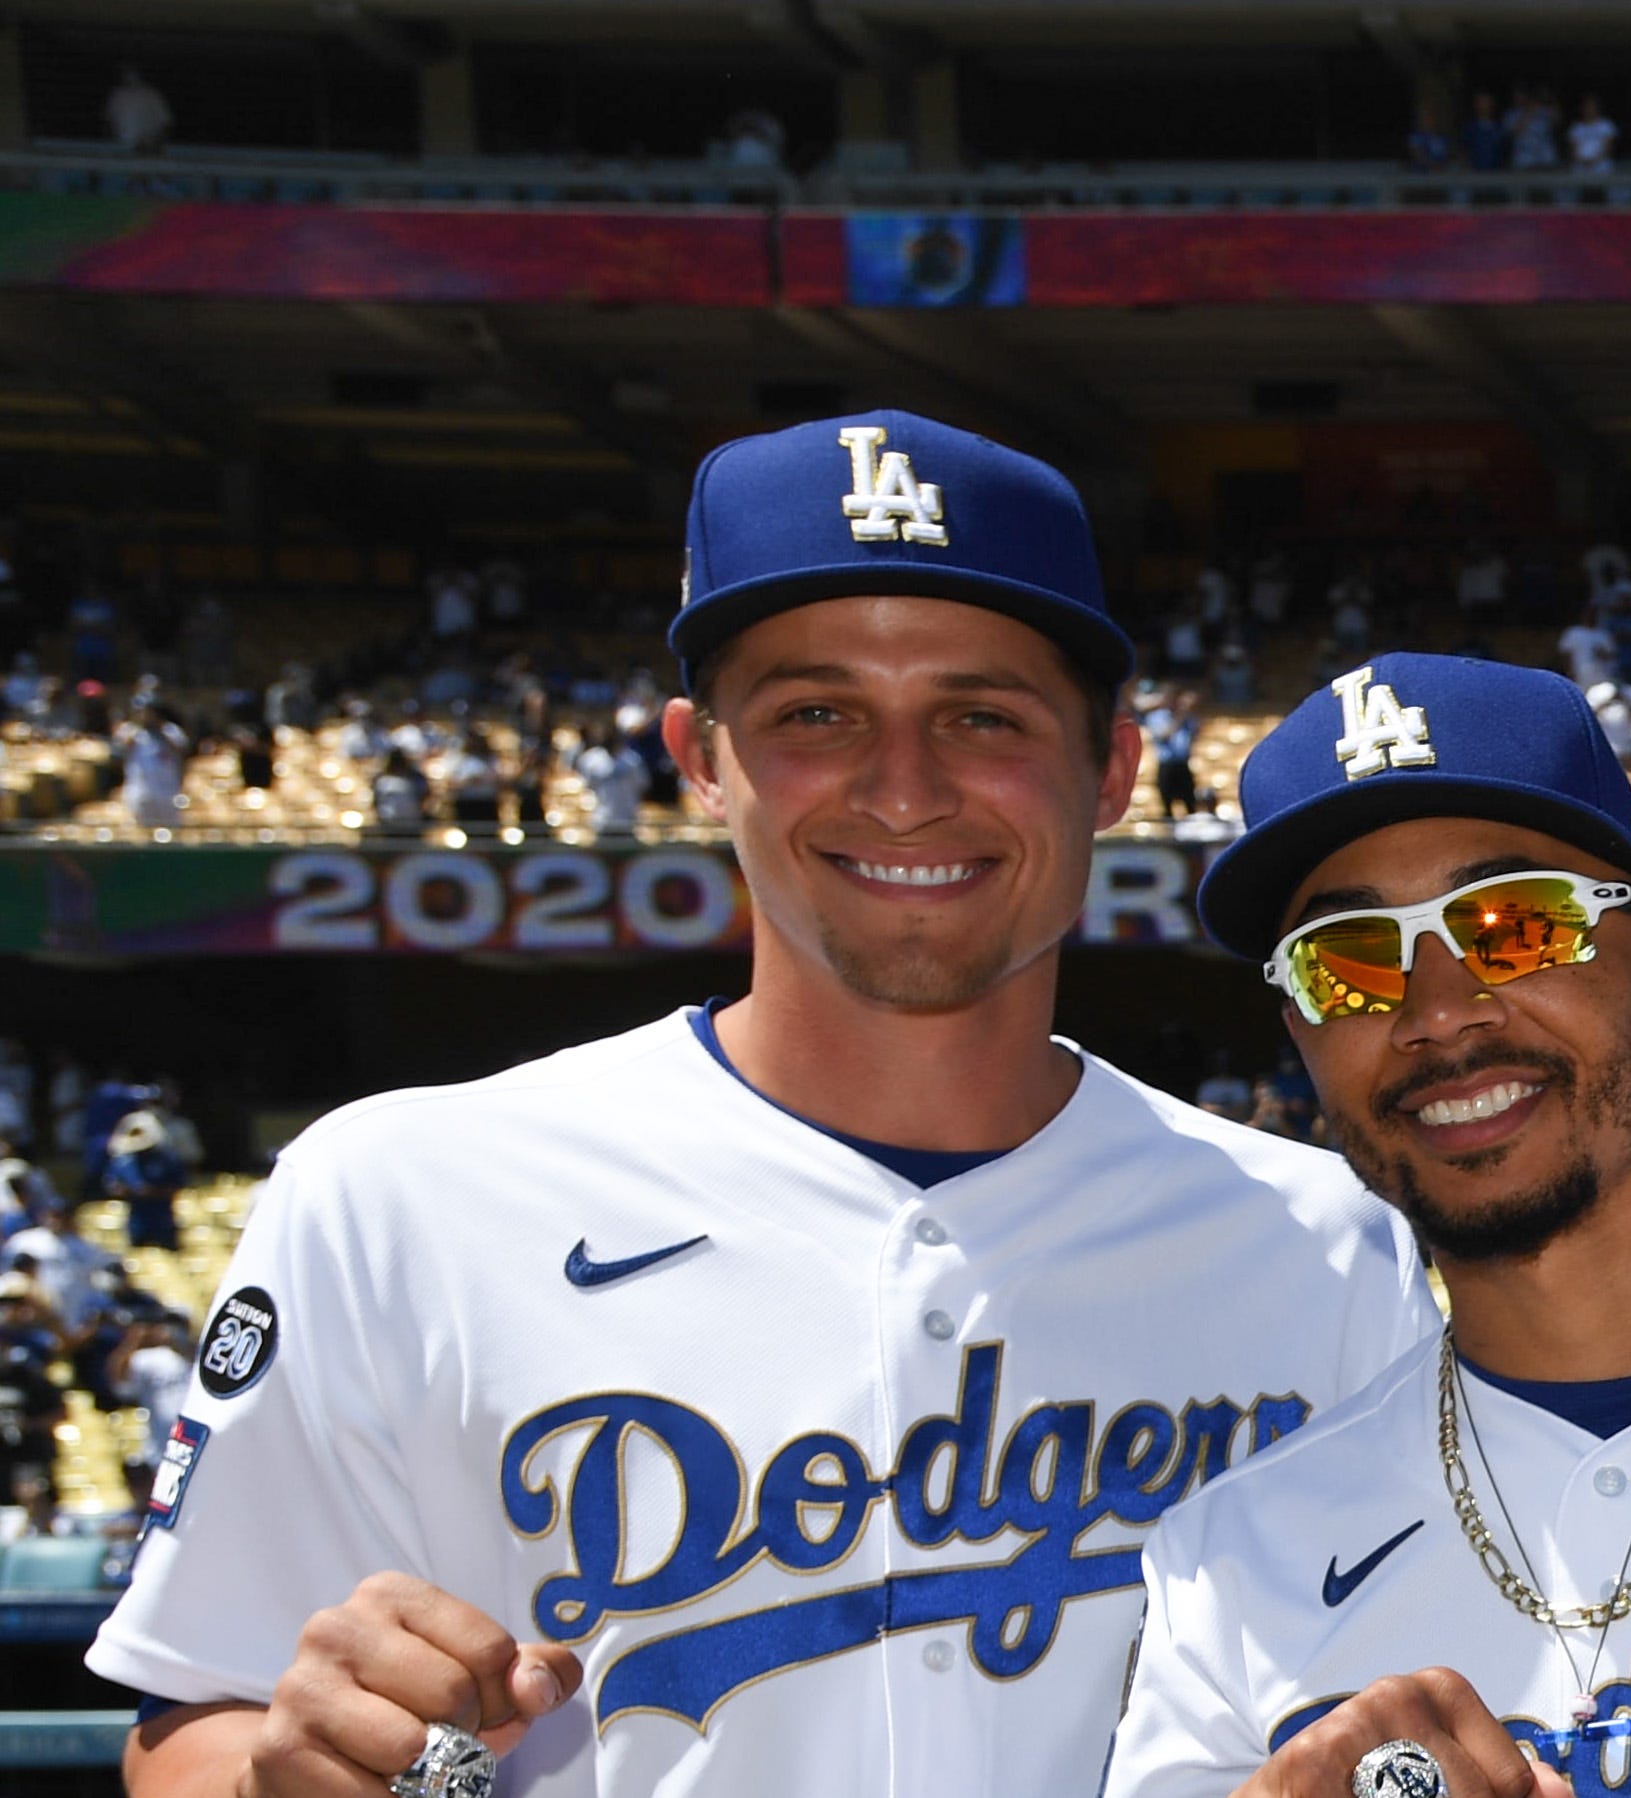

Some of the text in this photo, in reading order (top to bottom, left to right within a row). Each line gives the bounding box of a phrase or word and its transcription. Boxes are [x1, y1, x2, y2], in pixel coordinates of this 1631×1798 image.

[838, 427, 949, 546] LA
[1331, 665, 1437, 781] LA
[271, 852, 738, 949] 2020
[203, 1316, 263, 1381] 20
